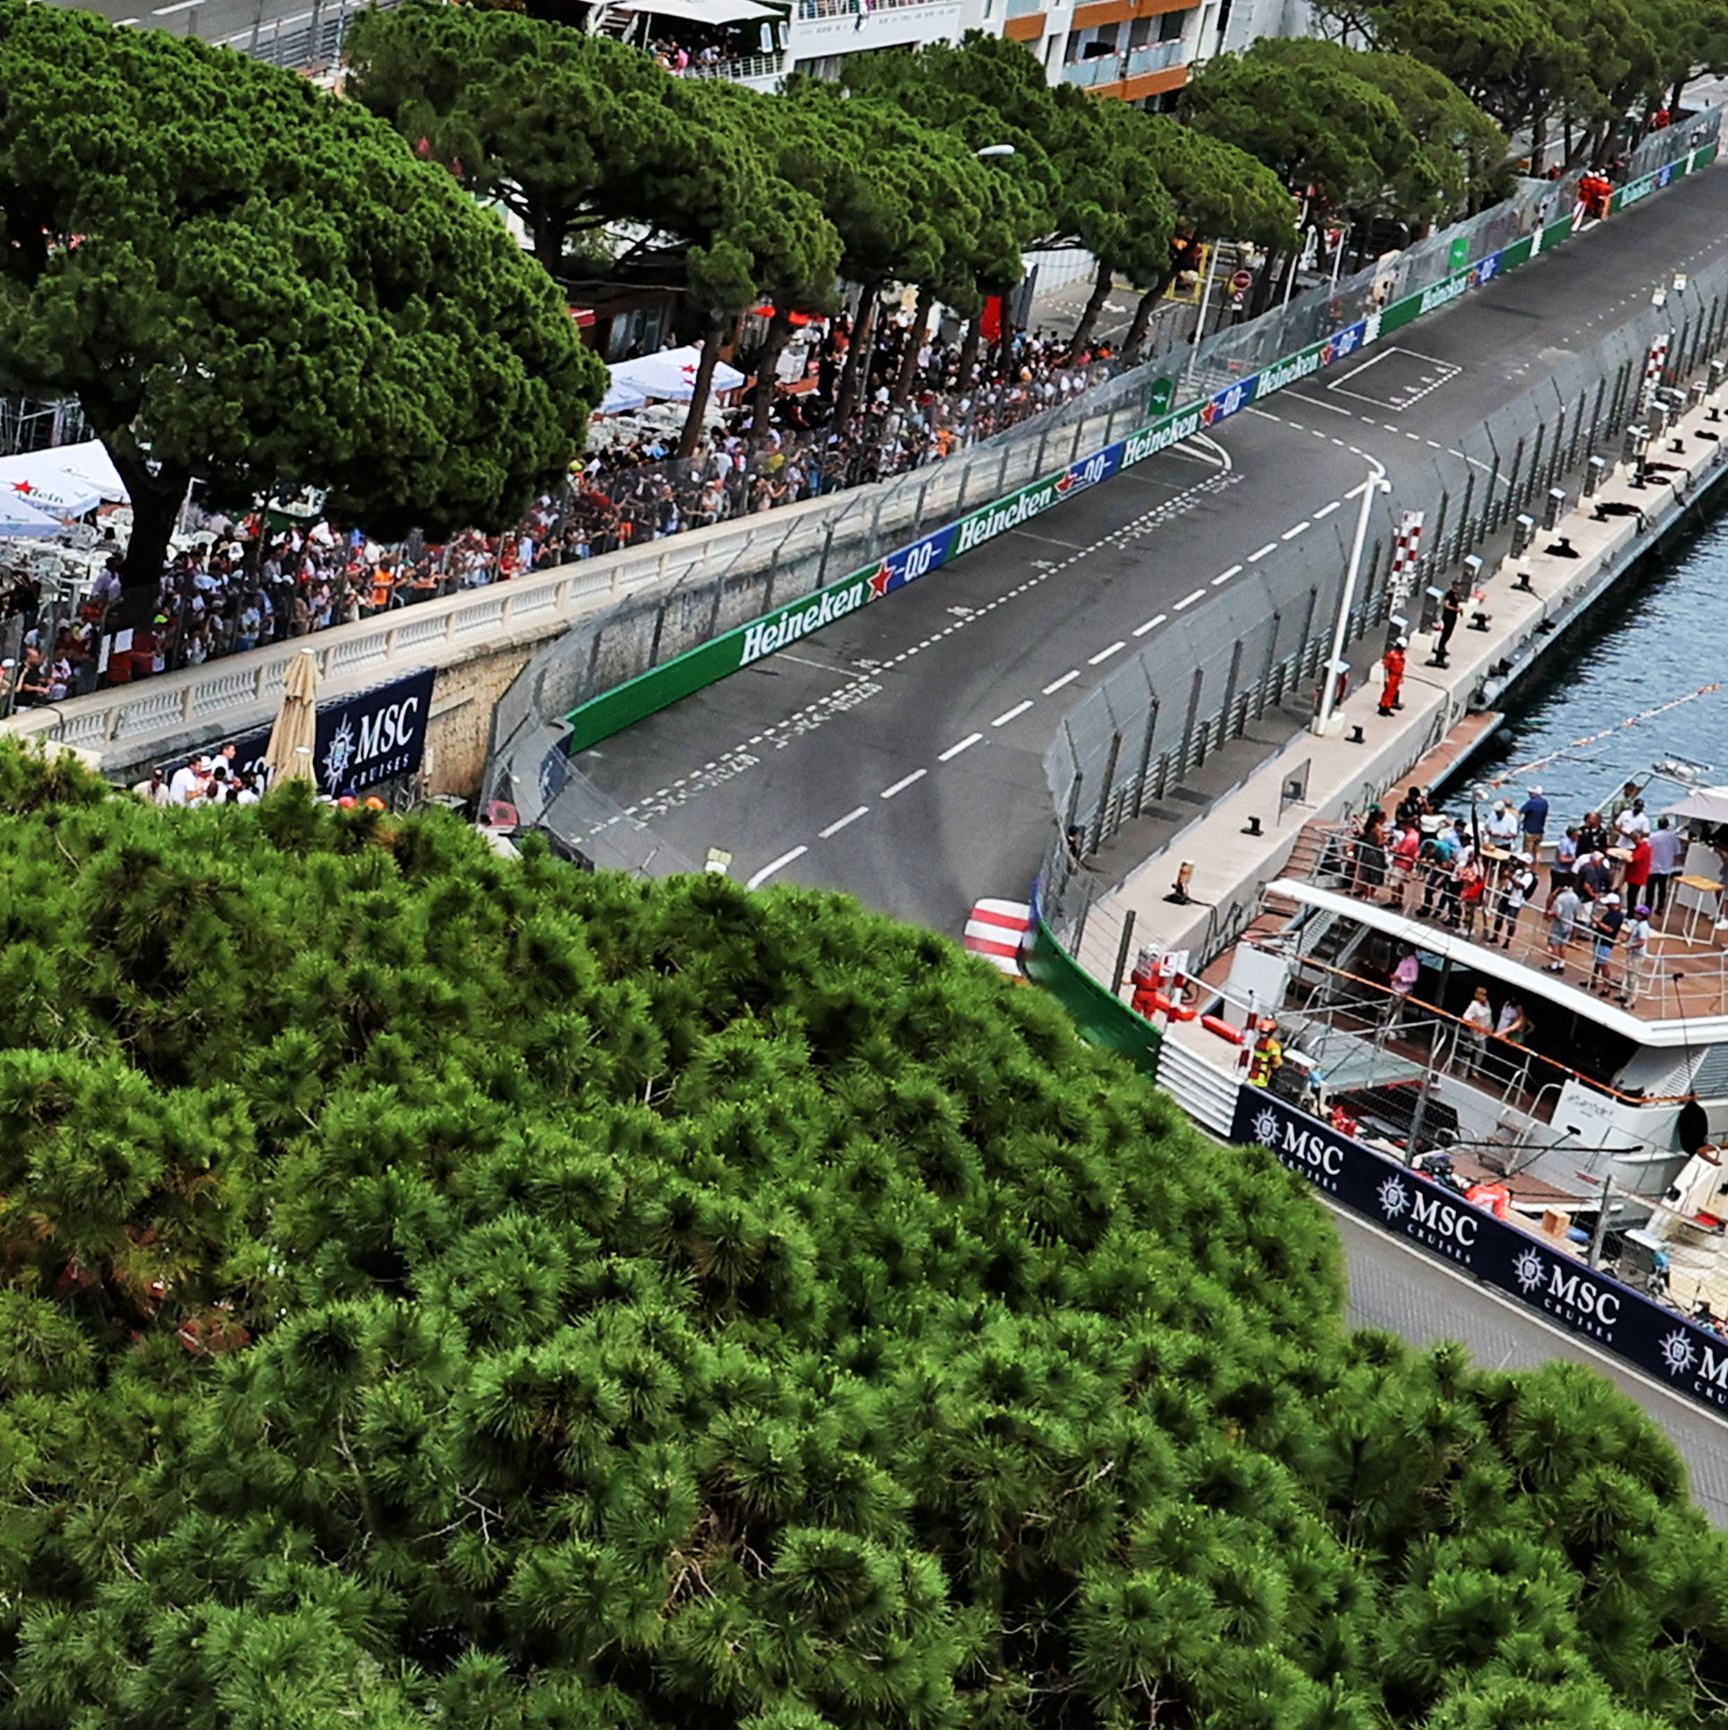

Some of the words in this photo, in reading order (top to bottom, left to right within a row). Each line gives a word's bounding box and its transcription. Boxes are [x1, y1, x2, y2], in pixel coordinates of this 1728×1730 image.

[1255, 353, 1319, 400] Heineken
[1121, 411, 1198, 469] Heineken
[956, 486, 1052, 555] Heineken
[739, 582, 864, 666] Heineken
[354, 697, 420, 766] MSC
[350, 752, 410, 791] CRUISES
[1281, 1122, 1343, 1177] MSC
[1407, 1222, 1472, 1265] CRUISES
[1410, 1191, 1478, 1247] MSC
[1544, 1298, 1614, 1344] CRUISES
[1549, 1266, 1621, 1326] MSC
